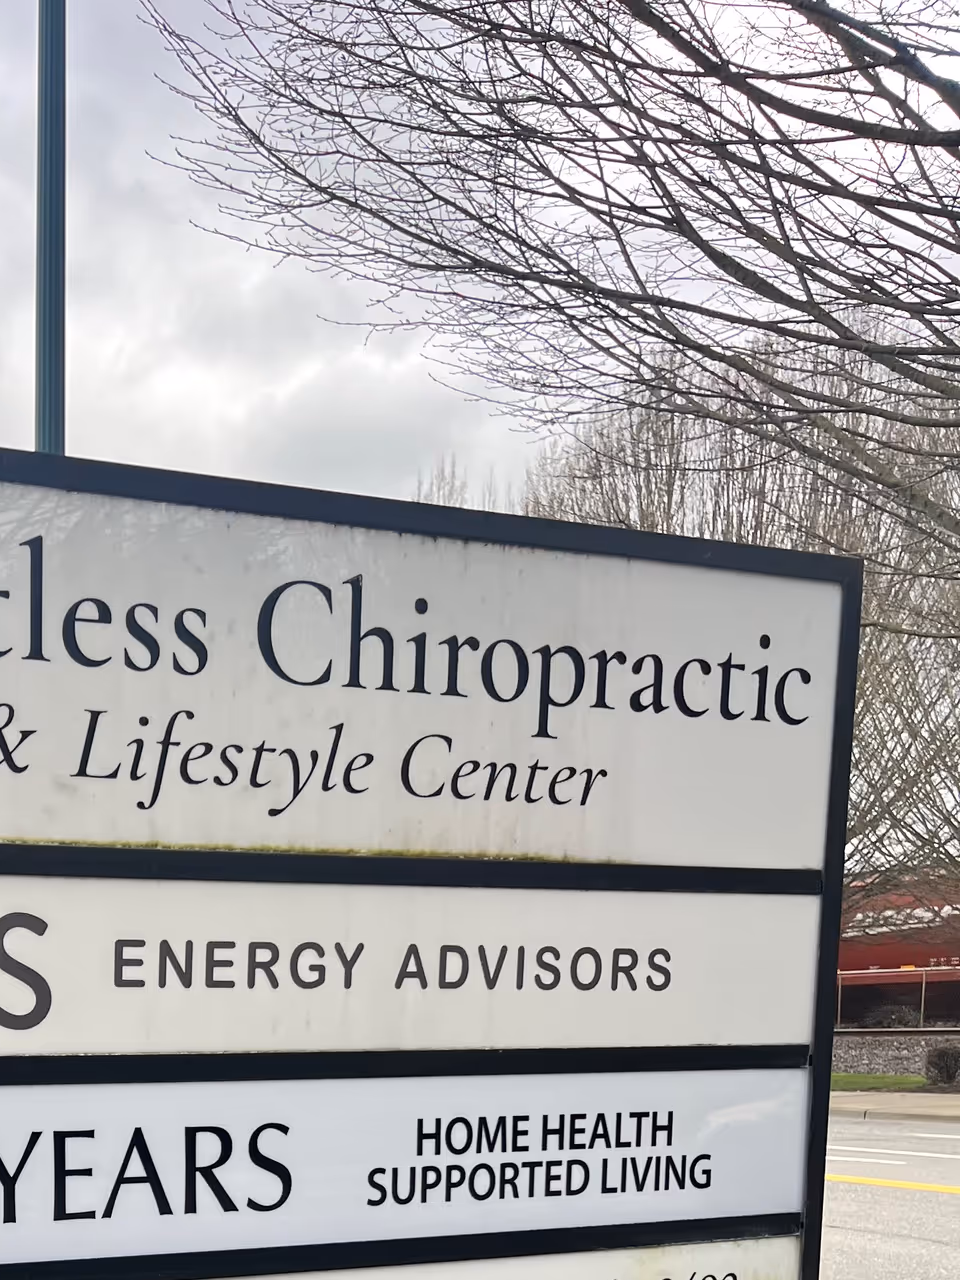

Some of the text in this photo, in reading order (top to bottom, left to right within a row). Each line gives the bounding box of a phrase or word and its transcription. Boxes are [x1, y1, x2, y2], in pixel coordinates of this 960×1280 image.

[257, 574, 813, 742] Chiropractic
[69, 708, 376, 817] Lifestyle
[400, 733, 608, 808] Center
[113, 938, 673, 993] ENERGY ADVISORS
[416, 1109, 675, 1158] HOME HEALTH
[365, 1153, 713, 1208] SUPPORTED LIVING
